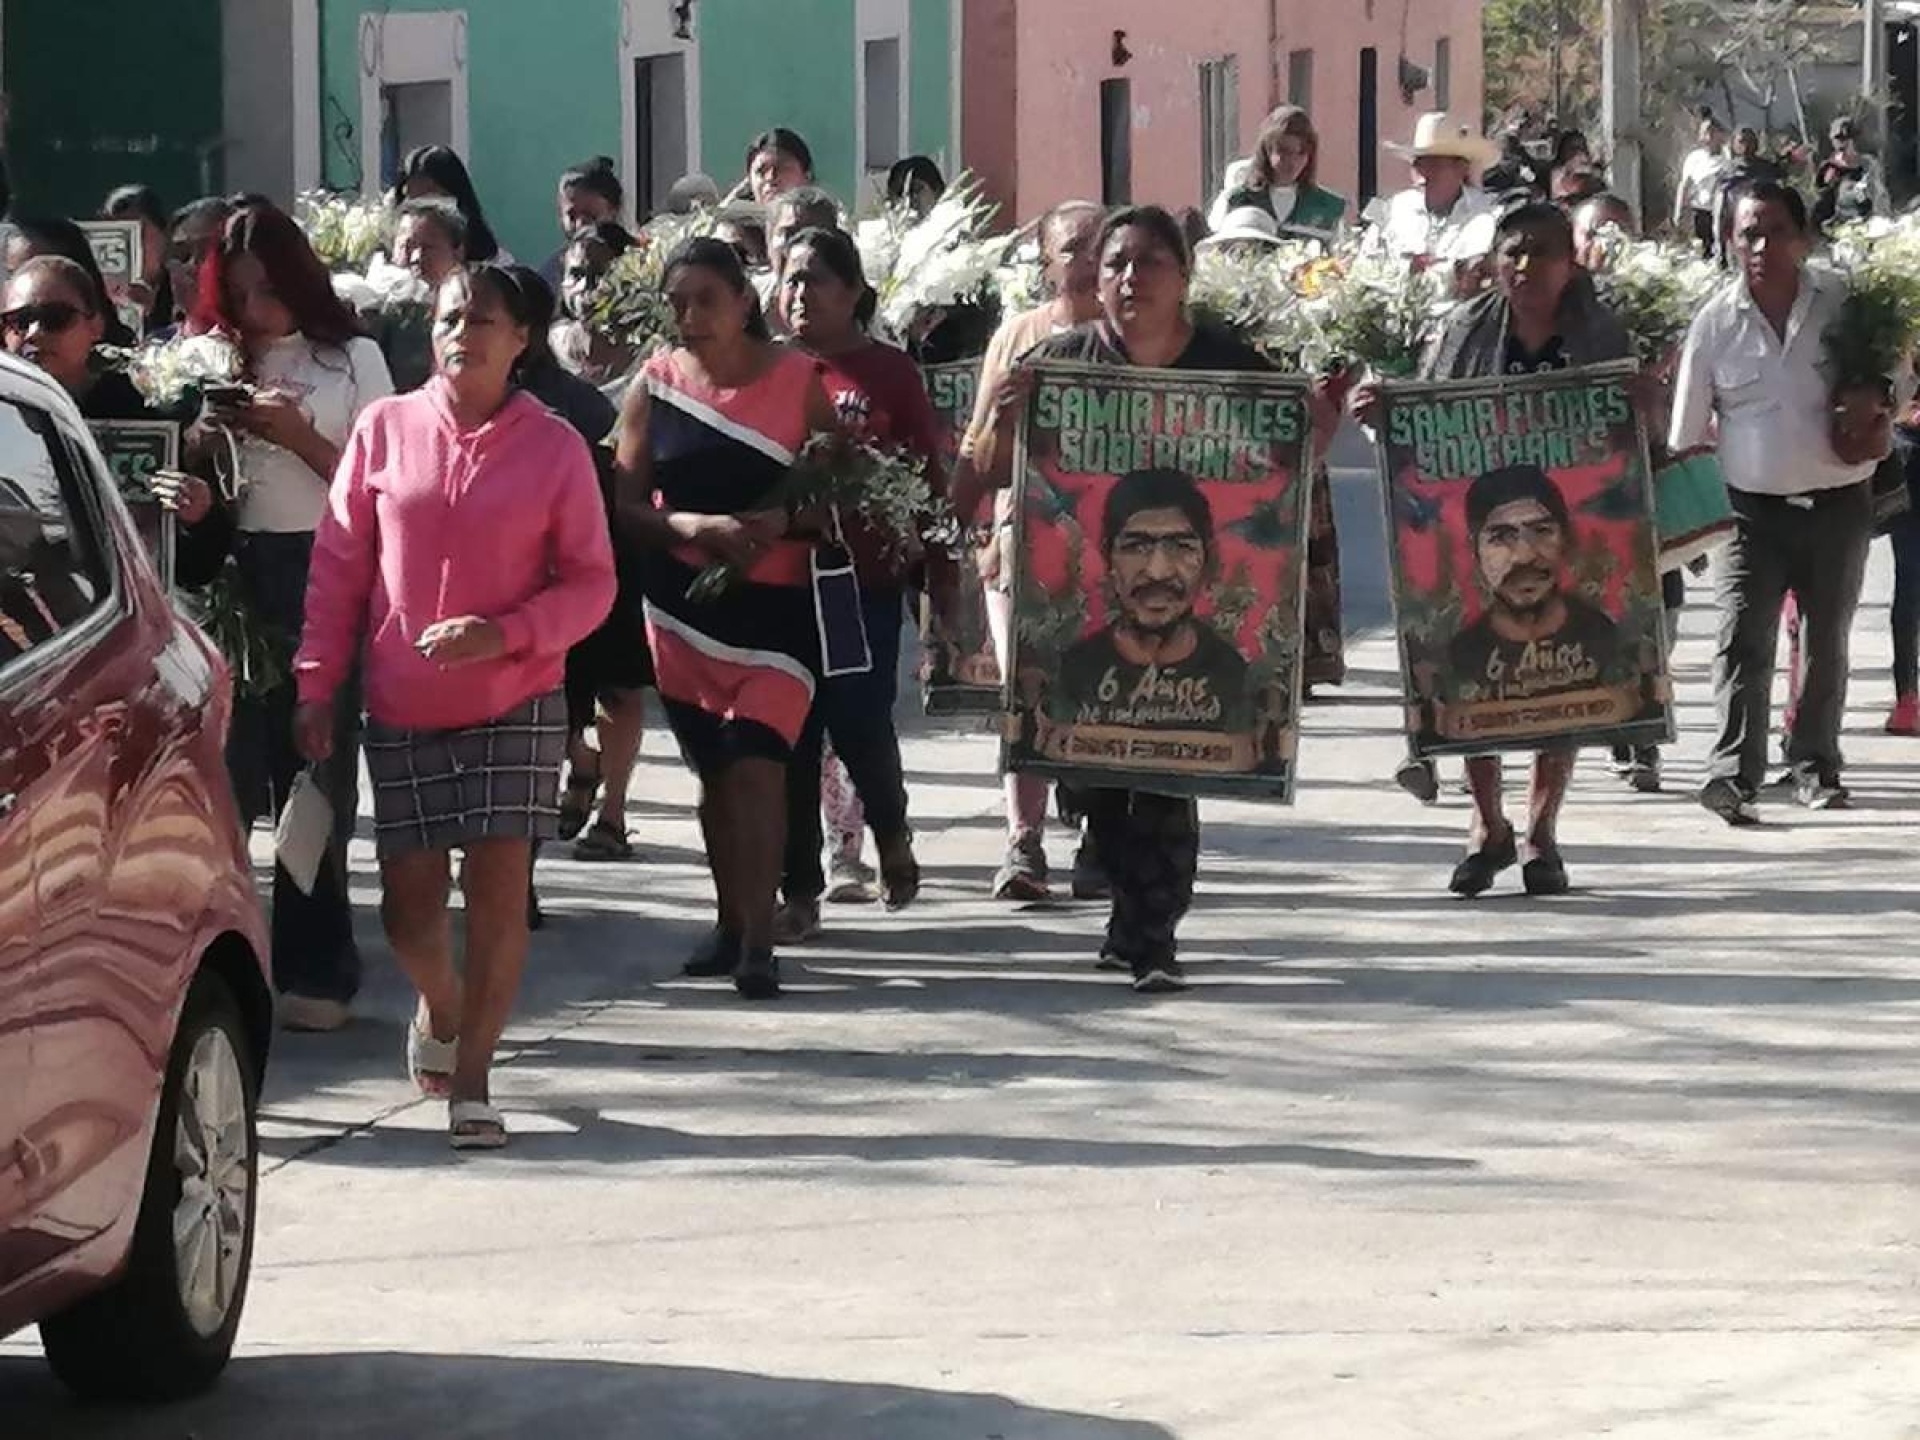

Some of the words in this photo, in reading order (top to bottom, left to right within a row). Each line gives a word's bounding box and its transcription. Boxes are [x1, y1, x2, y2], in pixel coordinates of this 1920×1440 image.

[1163, 391, 1301, 442] FLORES
[1485, 645, 1507, 681] 6
[1098, 665, 1119, 702] 6
